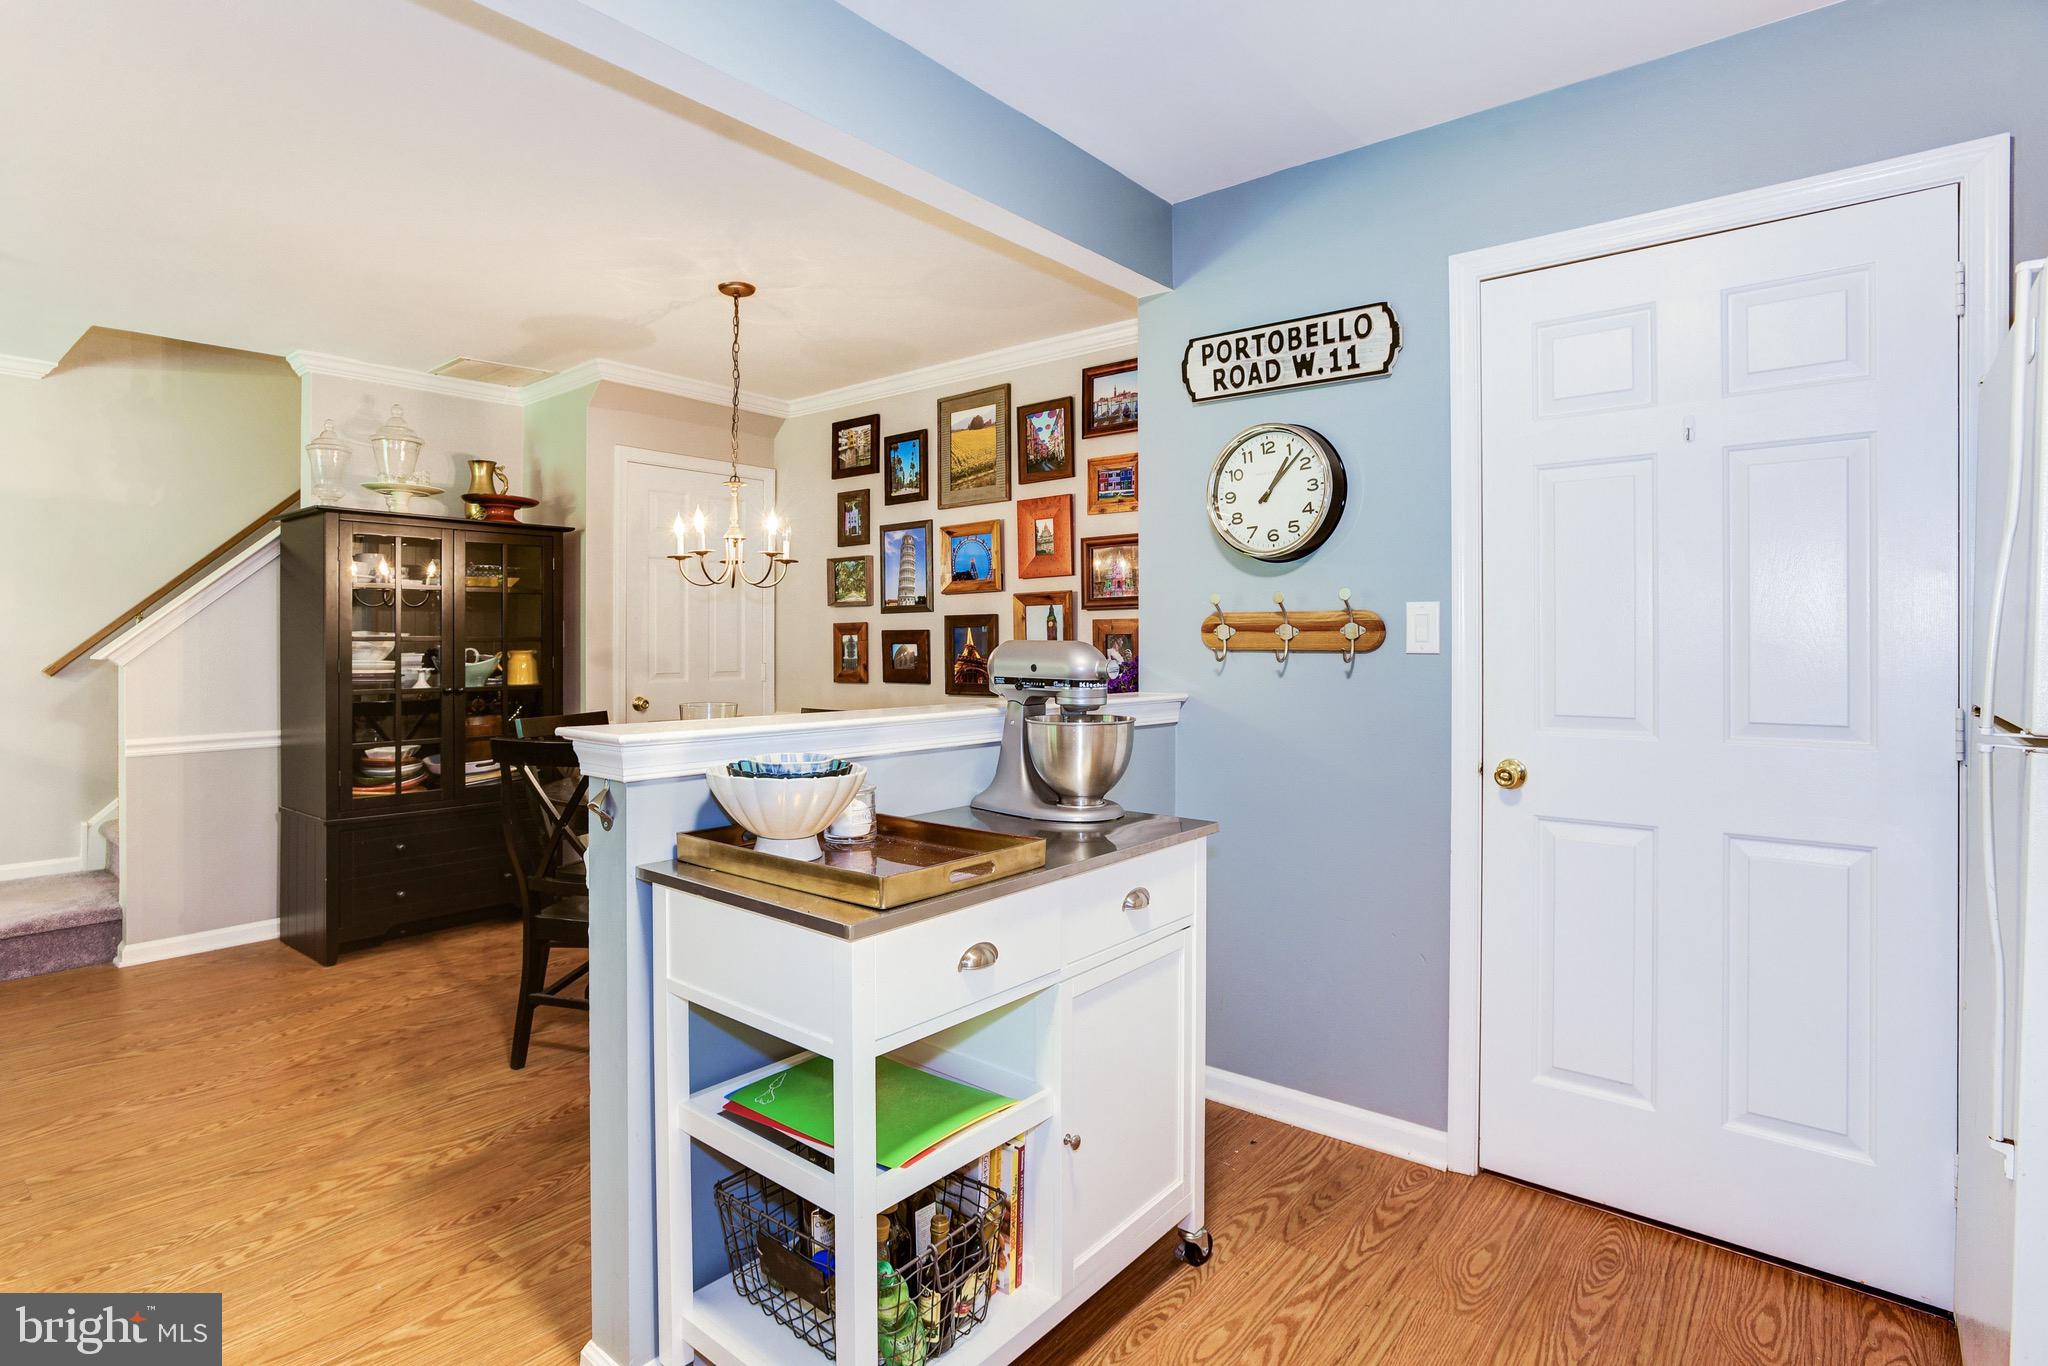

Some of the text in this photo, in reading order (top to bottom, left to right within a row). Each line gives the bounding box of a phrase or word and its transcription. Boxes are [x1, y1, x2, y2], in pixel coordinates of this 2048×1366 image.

[1202, 313, 1373, 367] PORTOBELLO
[1213, 345, 1360, 392] ROAD W.11
[1260, 441, 1276, 455] 12
[1242, 450, 1253, 464] 11
[1300, 456, 1312, 470] 2
[1228, 468, 1244, 482] 10
[1306, 478, 1319, 492] 3
[1224, 492, 1236, 504] 9
[1302, 502, 1314, 515] 4
[1231, 512, 1244, 525] 8
[1246, 526, 1258, 540] 7
[1288, 520, 1300, 534] 5
[1267, 529, 1280, 542] 6
